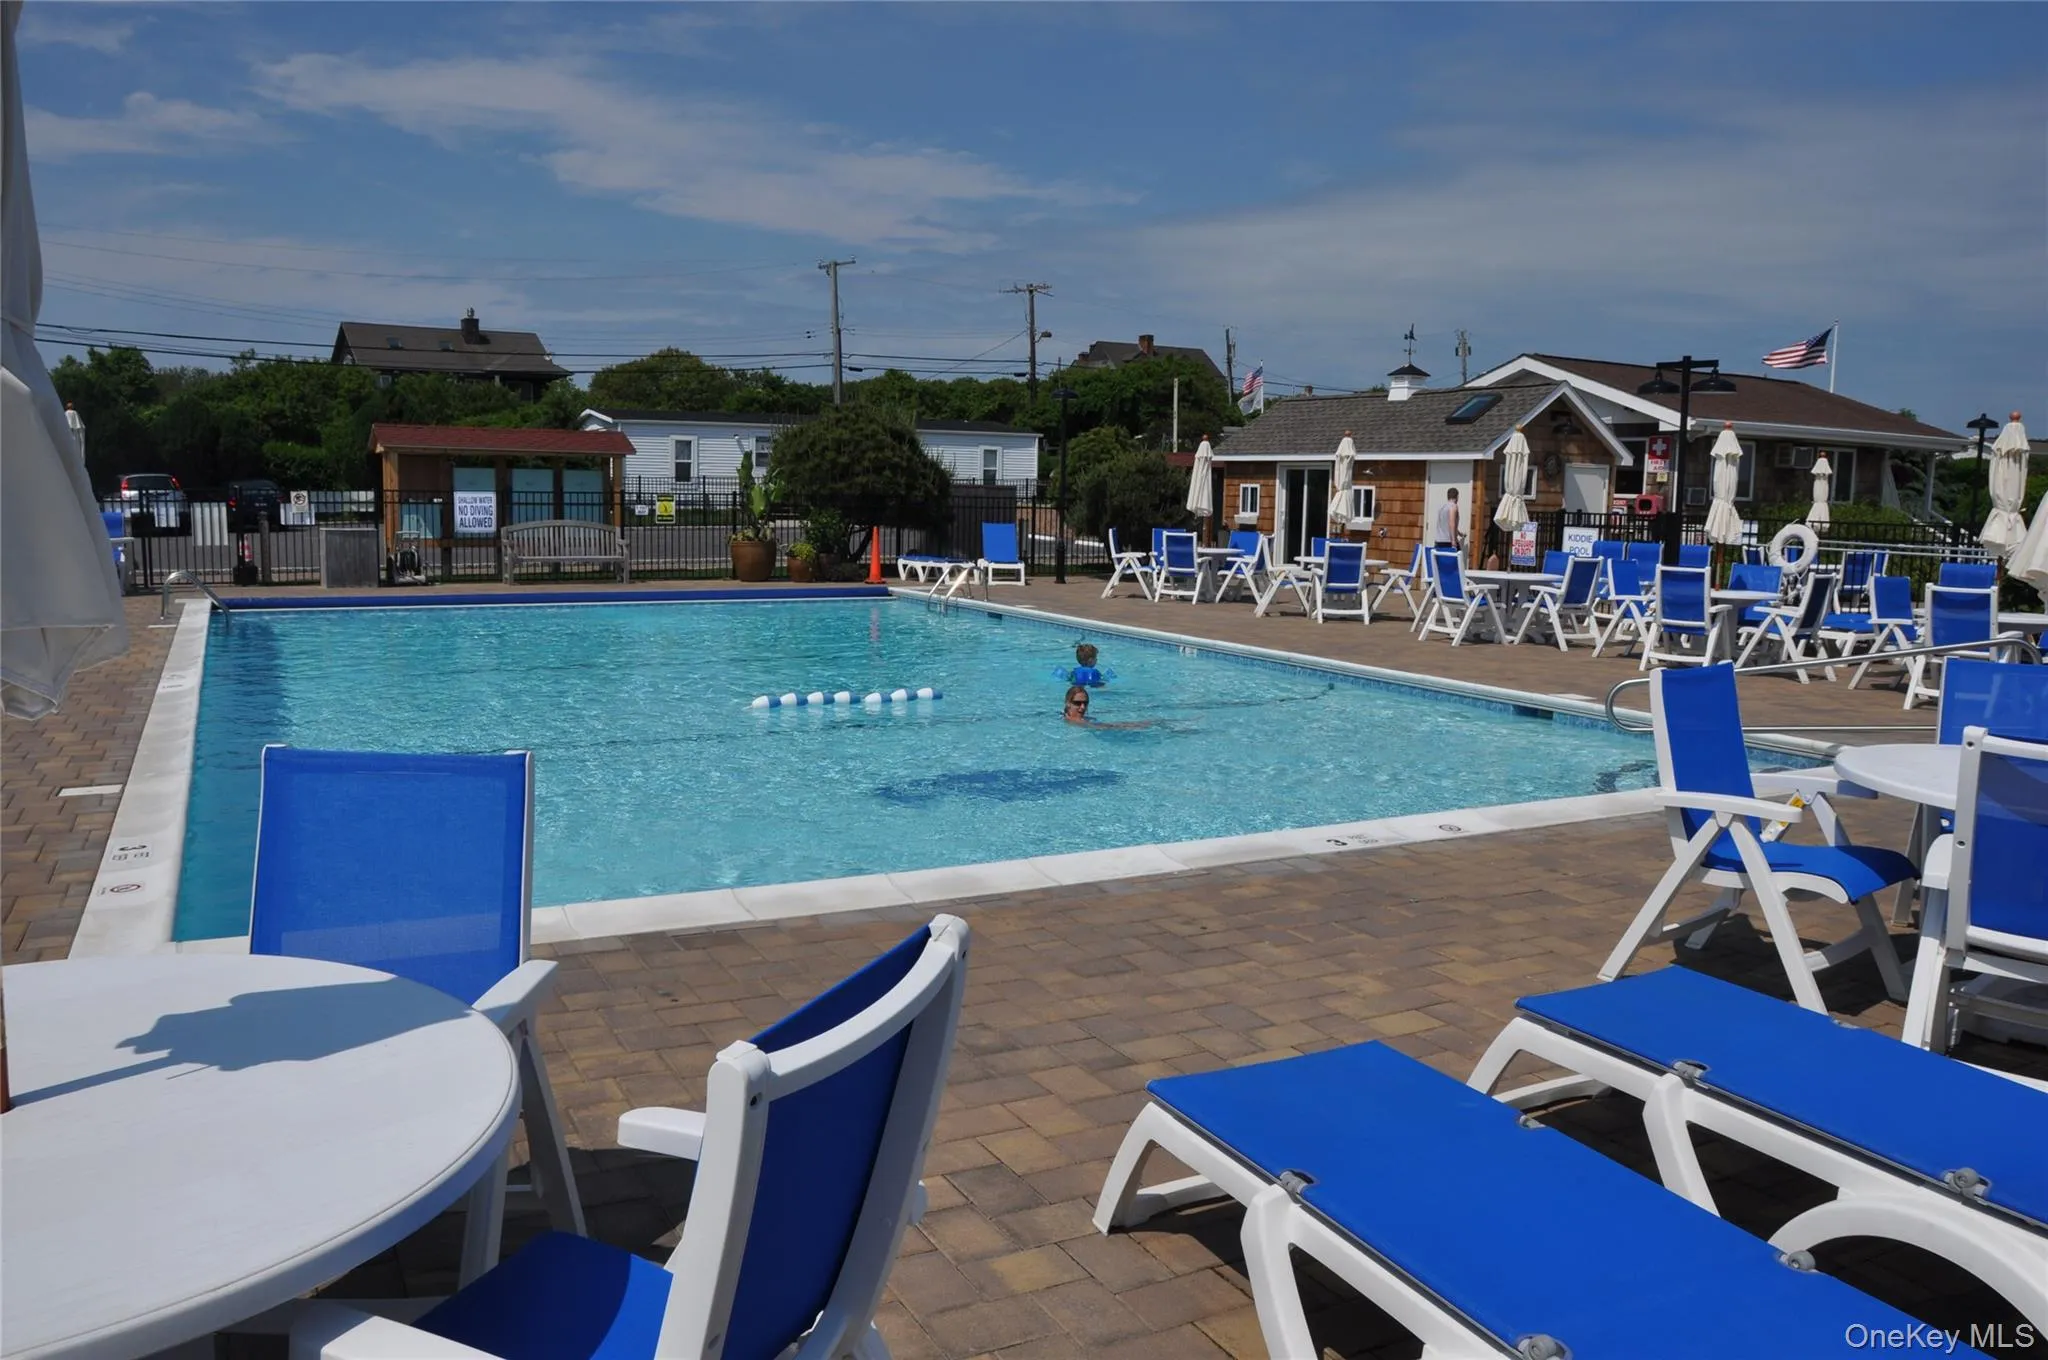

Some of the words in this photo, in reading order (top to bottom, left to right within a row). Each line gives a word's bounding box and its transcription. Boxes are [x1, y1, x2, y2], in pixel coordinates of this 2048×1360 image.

[479, 496, 493, 504] WATER
[458, 504, 468, 516] NO
[470, 504, 493, 516] DIVING
[459, 516, 493, 528] ALLOWED
[1568, 534, 1593, 543] KIDDIE
[1570, 546, 1590, 555] POOL
